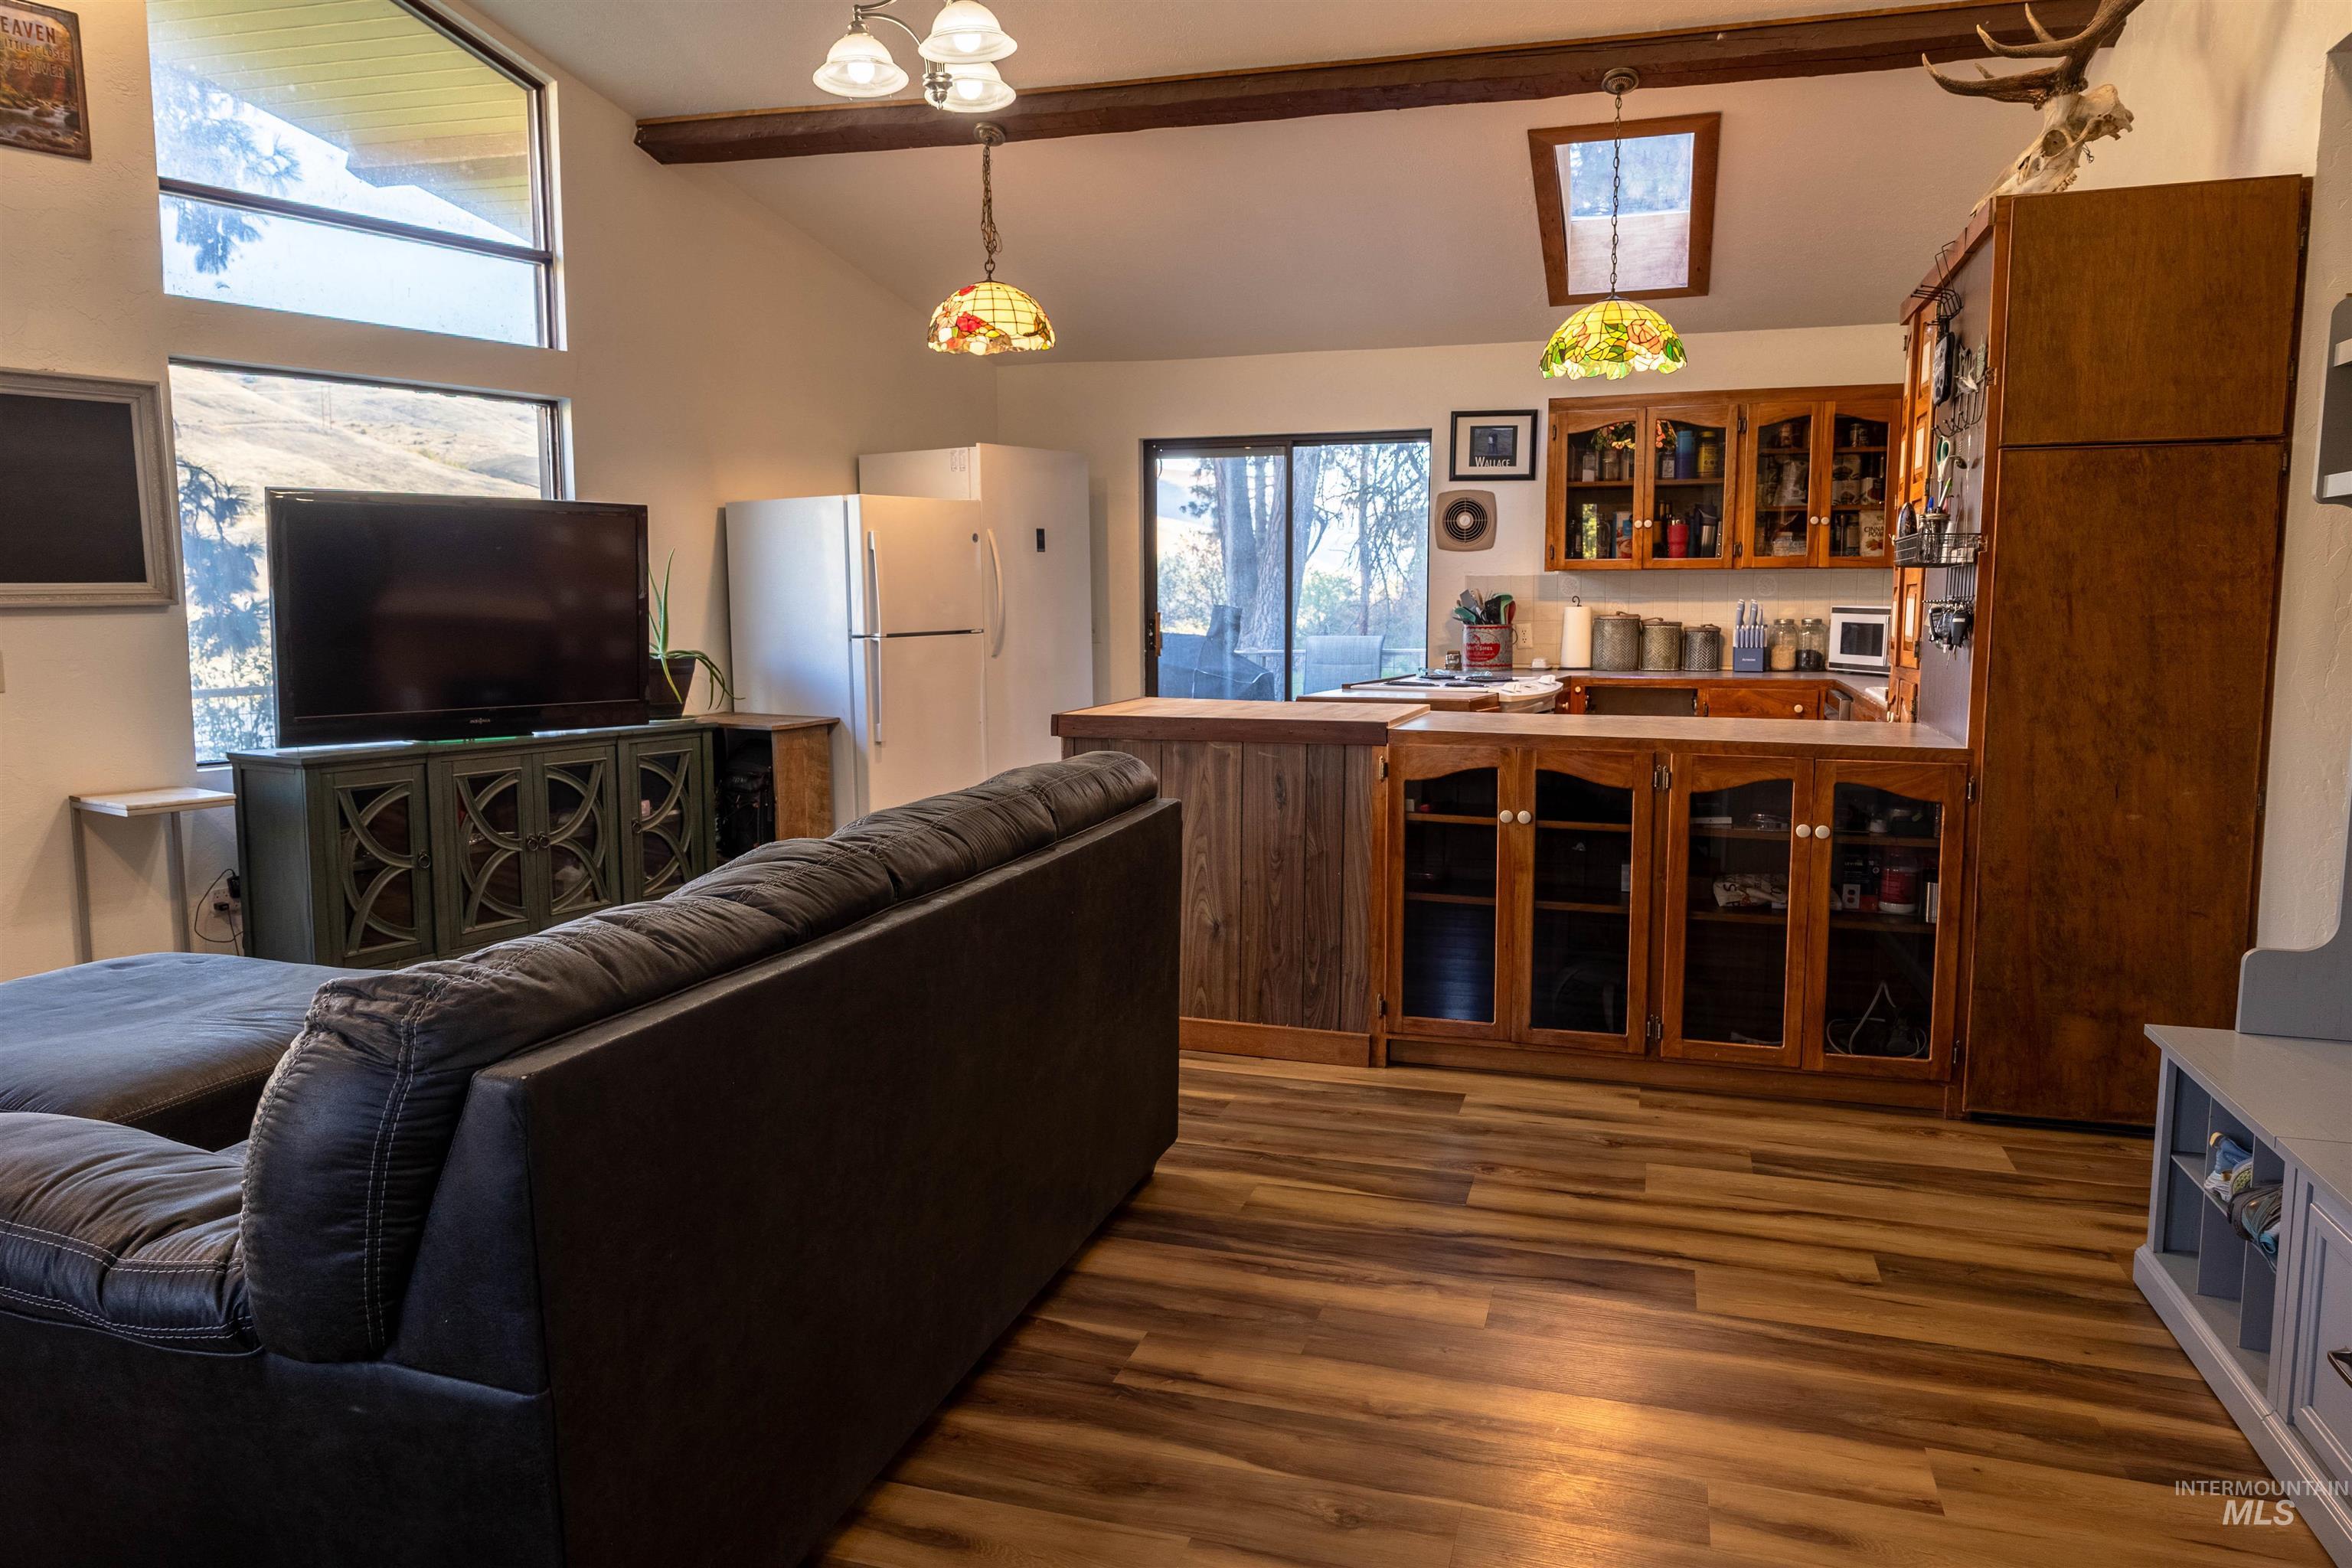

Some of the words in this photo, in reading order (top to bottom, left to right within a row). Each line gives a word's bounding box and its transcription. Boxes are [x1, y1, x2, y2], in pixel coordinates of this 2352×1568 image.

[34, 45, 70, 60] CLOSER
[27, 60, 66, 79] RIVER
[1475, 456, 1511, 468] WALLACE
